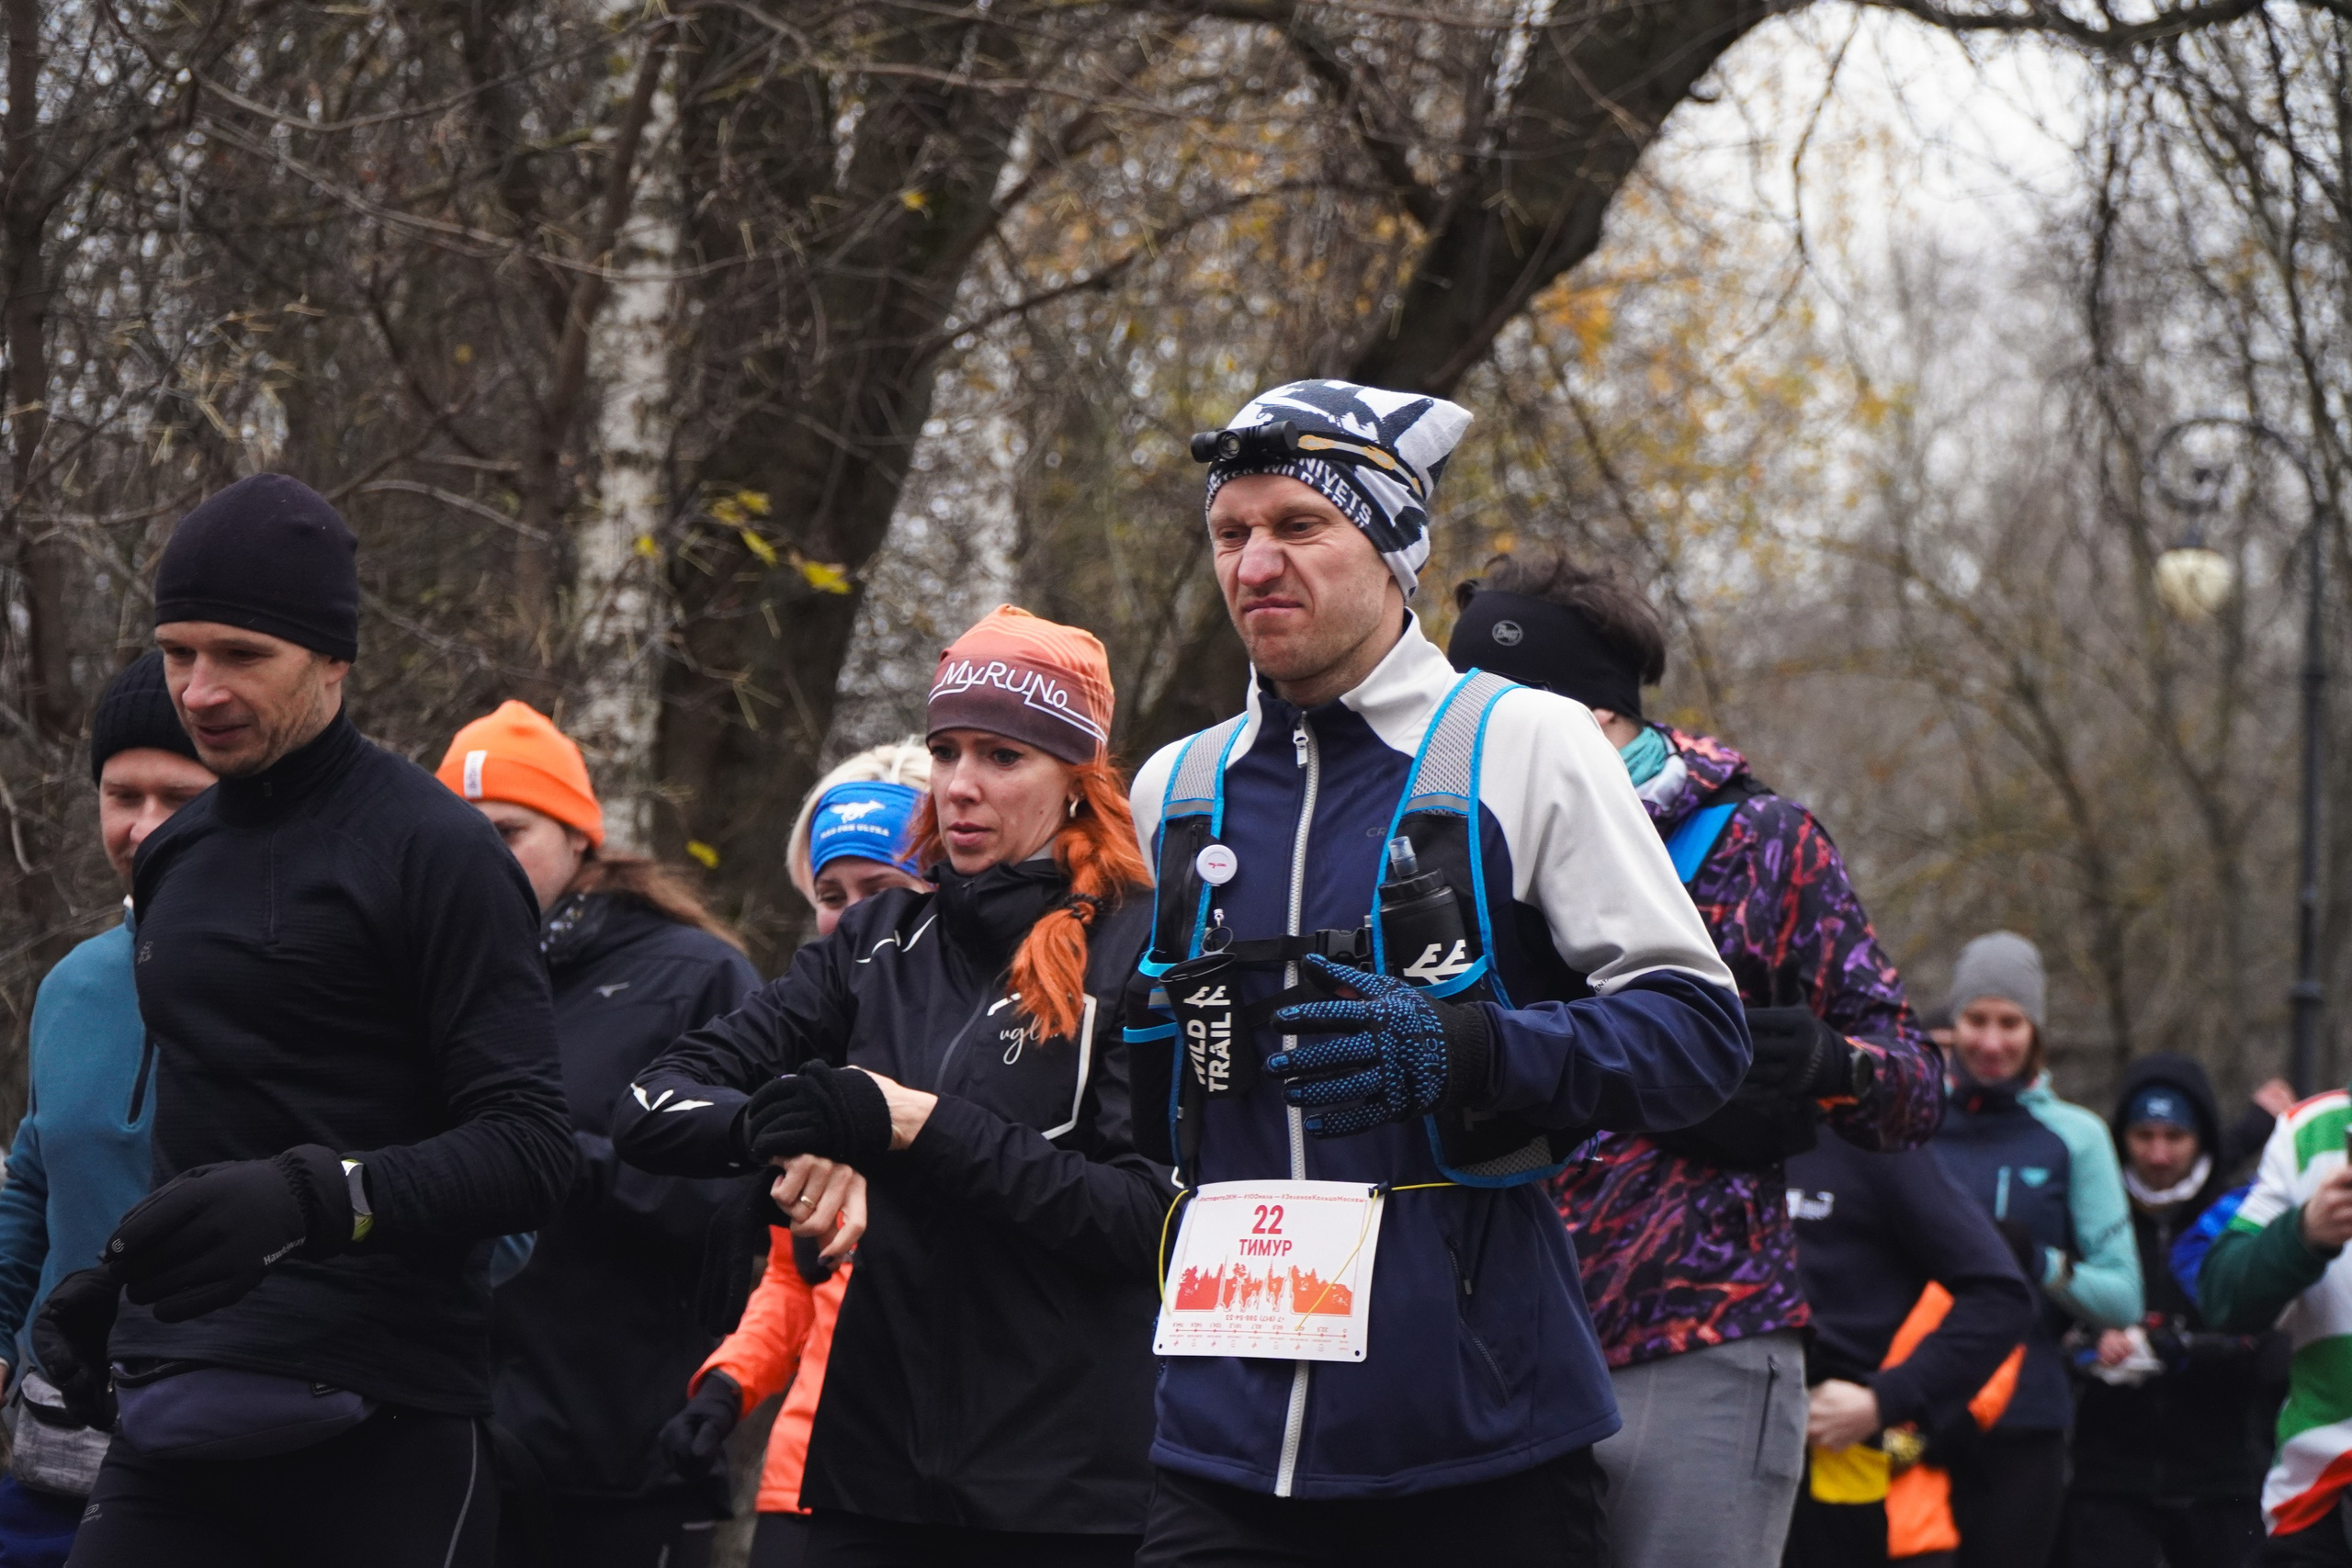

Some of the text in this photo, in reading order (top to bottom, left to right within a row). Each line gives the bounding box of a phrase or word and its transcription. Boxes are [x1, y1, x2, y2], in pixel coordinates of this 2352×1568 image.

[1186, 1018, 1207, 1086] WILD
[1207, 1011, 1232, 1093] TRAIL
[1251, 1204, 1284, 1235] 22
[1238, 1238, 1293, 1258] ТИМУР
